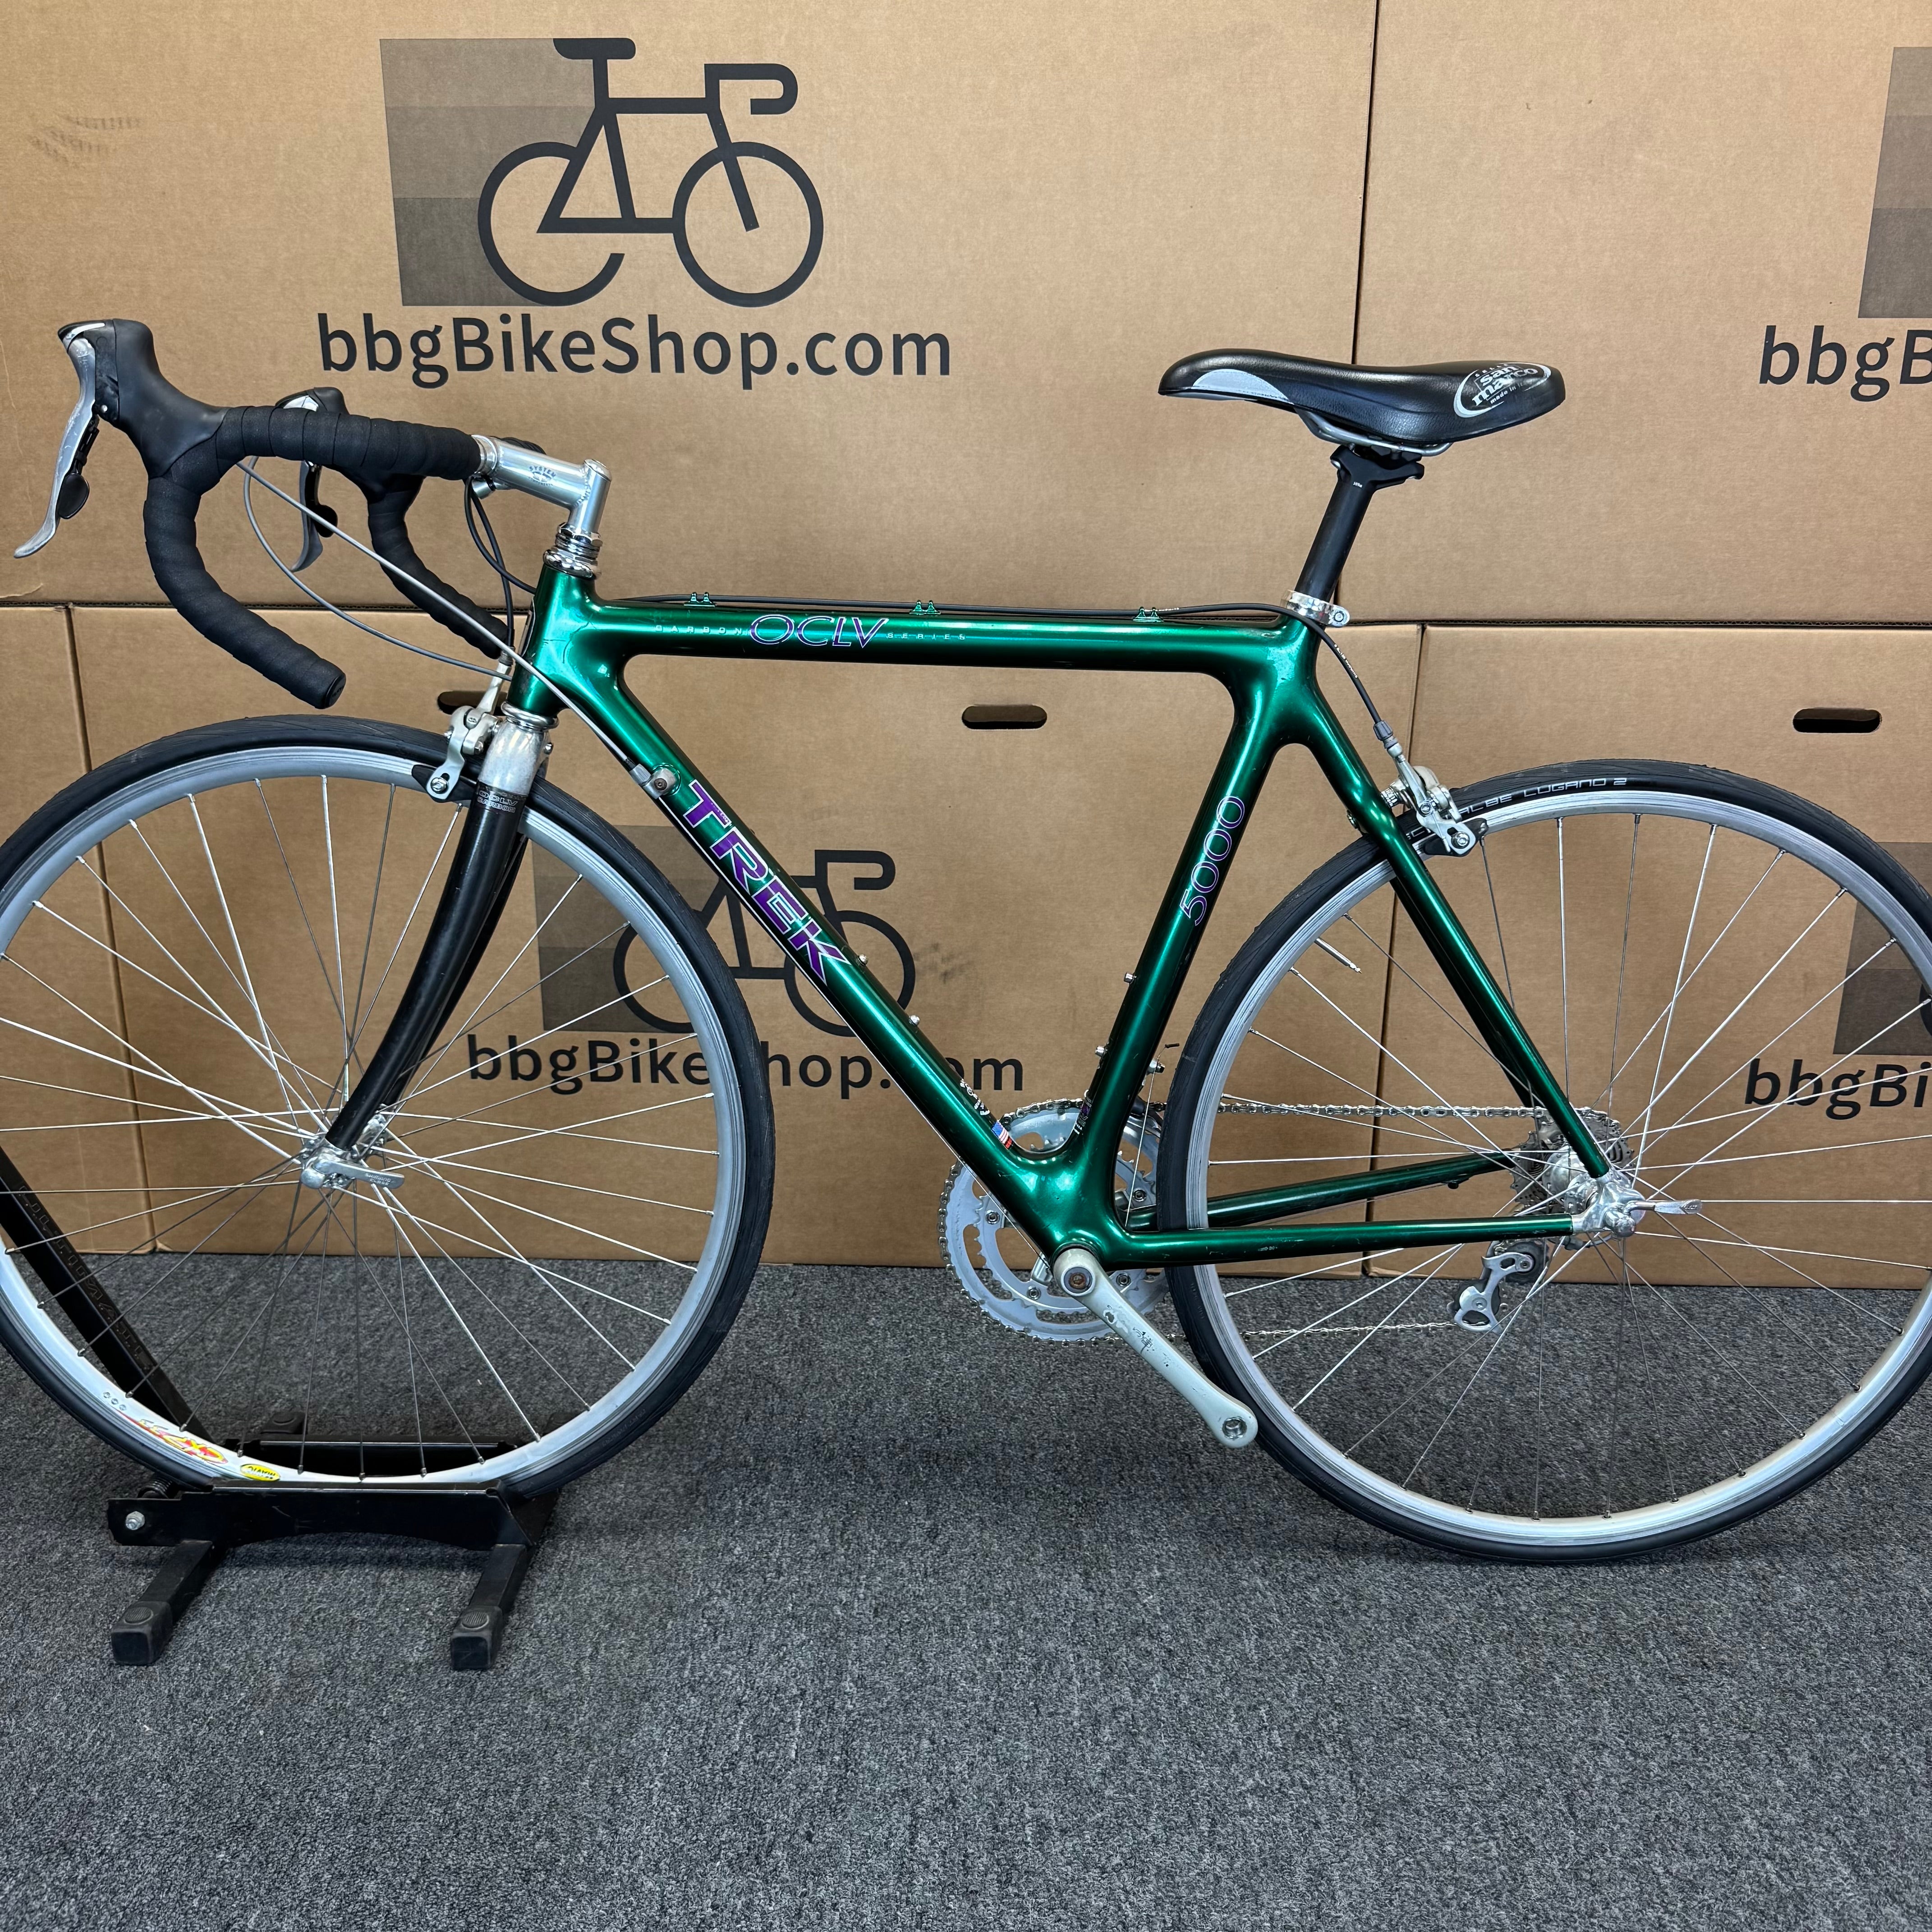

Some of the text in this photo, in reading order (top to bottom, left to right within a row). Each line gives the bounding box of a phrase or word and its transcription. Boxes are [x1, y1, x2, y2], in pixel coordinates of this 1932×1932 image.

[318, 313, 950, 390] bbgBikeShop.com
[750, 614, 889, 648] OCLV
[478, 797, 516, 813] CARBON
[479, 791, 518, 806] OCLV
[1523, 777, 1606, 798] LUGANO
[1613, 777, 1627, 786] 2
[682, 779, 852, 986] TREK
[1179, 796, 1245, 926] 5000
[1745, 1058, 1931, 1120] bbgBi
